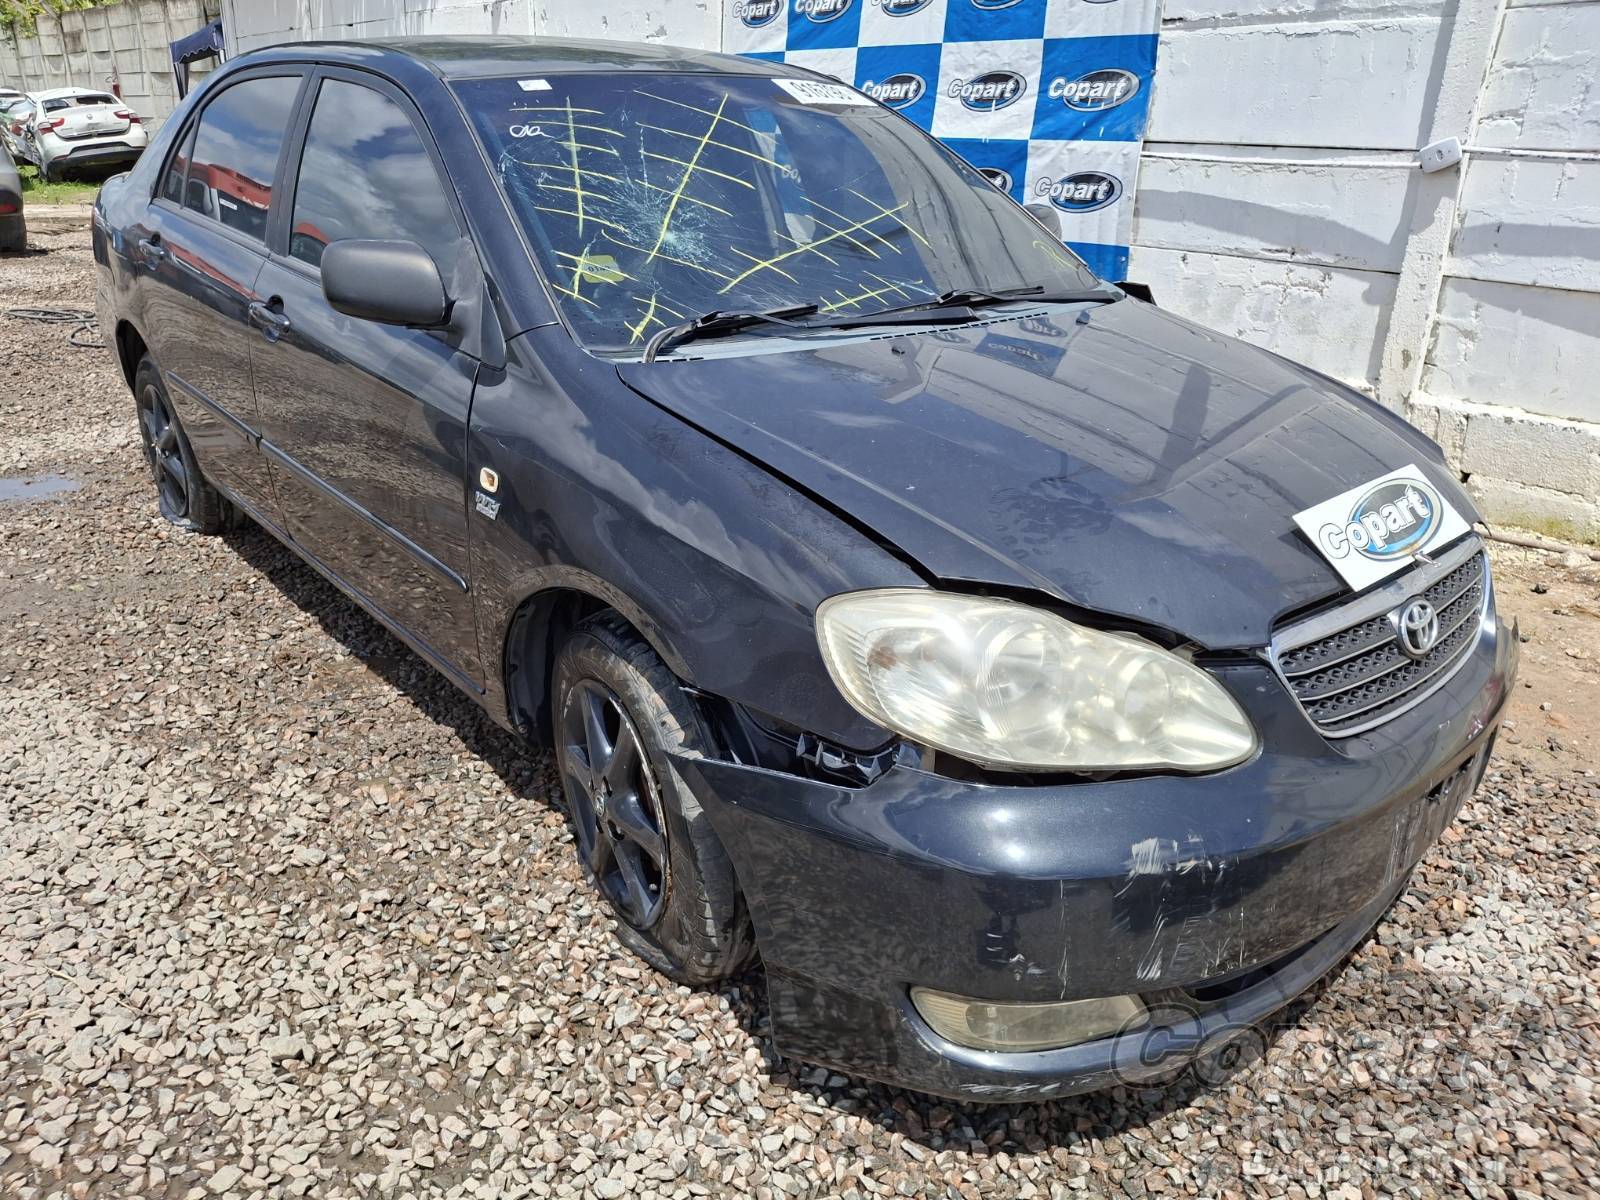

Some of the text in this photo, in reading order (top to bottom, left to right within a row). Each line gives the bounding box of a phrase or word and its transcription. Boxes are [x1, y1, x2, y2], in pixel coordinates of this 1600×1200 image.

[732, 0, 776, 19] Copart
[862, 79, 918, 102] Copart
[947, 77, 1017, 102] Copart
[1048, 76, 1127, 102] Copart
[1034, 177, 1110, 203] Copart
[1318, 484, 1430, 559] Copart
